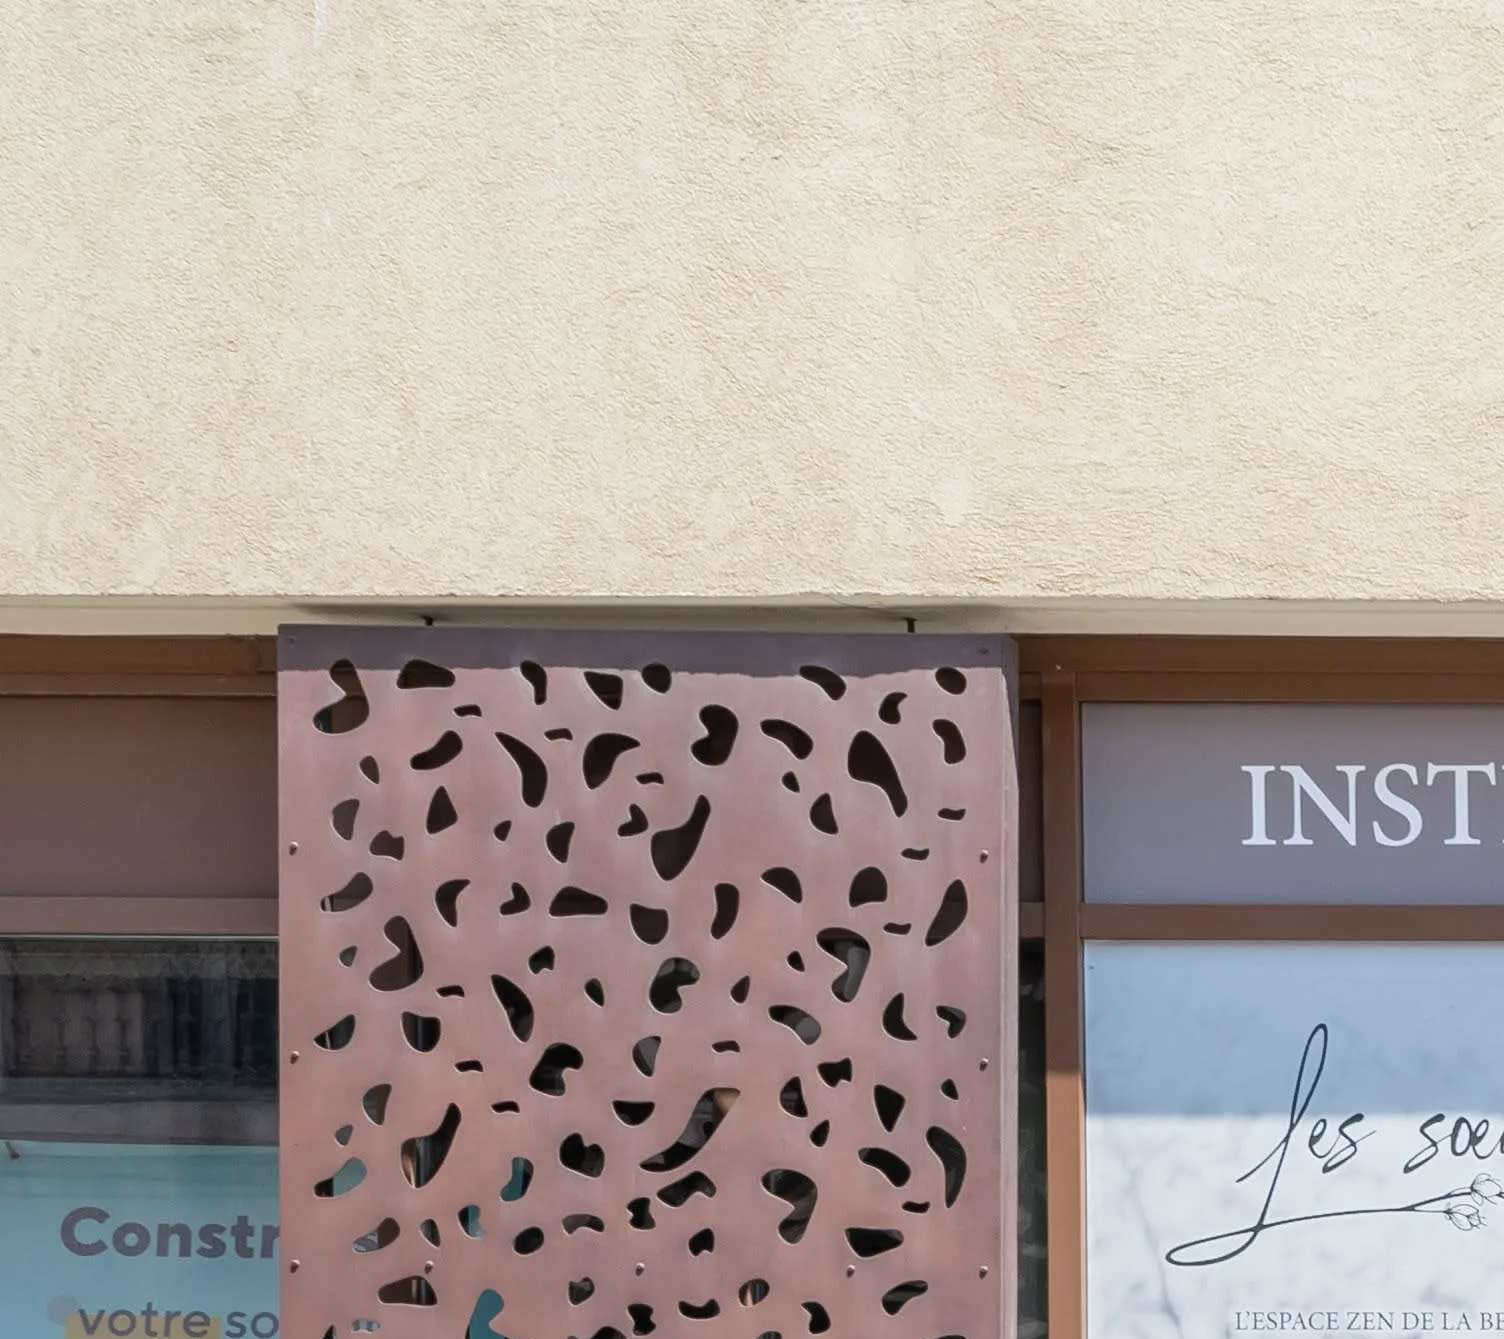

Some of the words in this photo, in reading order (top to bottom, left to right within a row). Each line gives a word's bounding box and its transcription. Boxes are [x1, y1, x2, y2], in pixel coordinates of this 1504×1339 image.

[1165, 1023, 1376, 1266] Les
[60, 1206, 279, 1259] Constr
[78, 1302, 211, 1338] votre
[225, 1311, 279, 1339] so
[1346, 1311, 1395, 1331] ZEN
[1402, 1311, 1435, 1331] DE
[1441, 1311, 1473, 1331] LA
